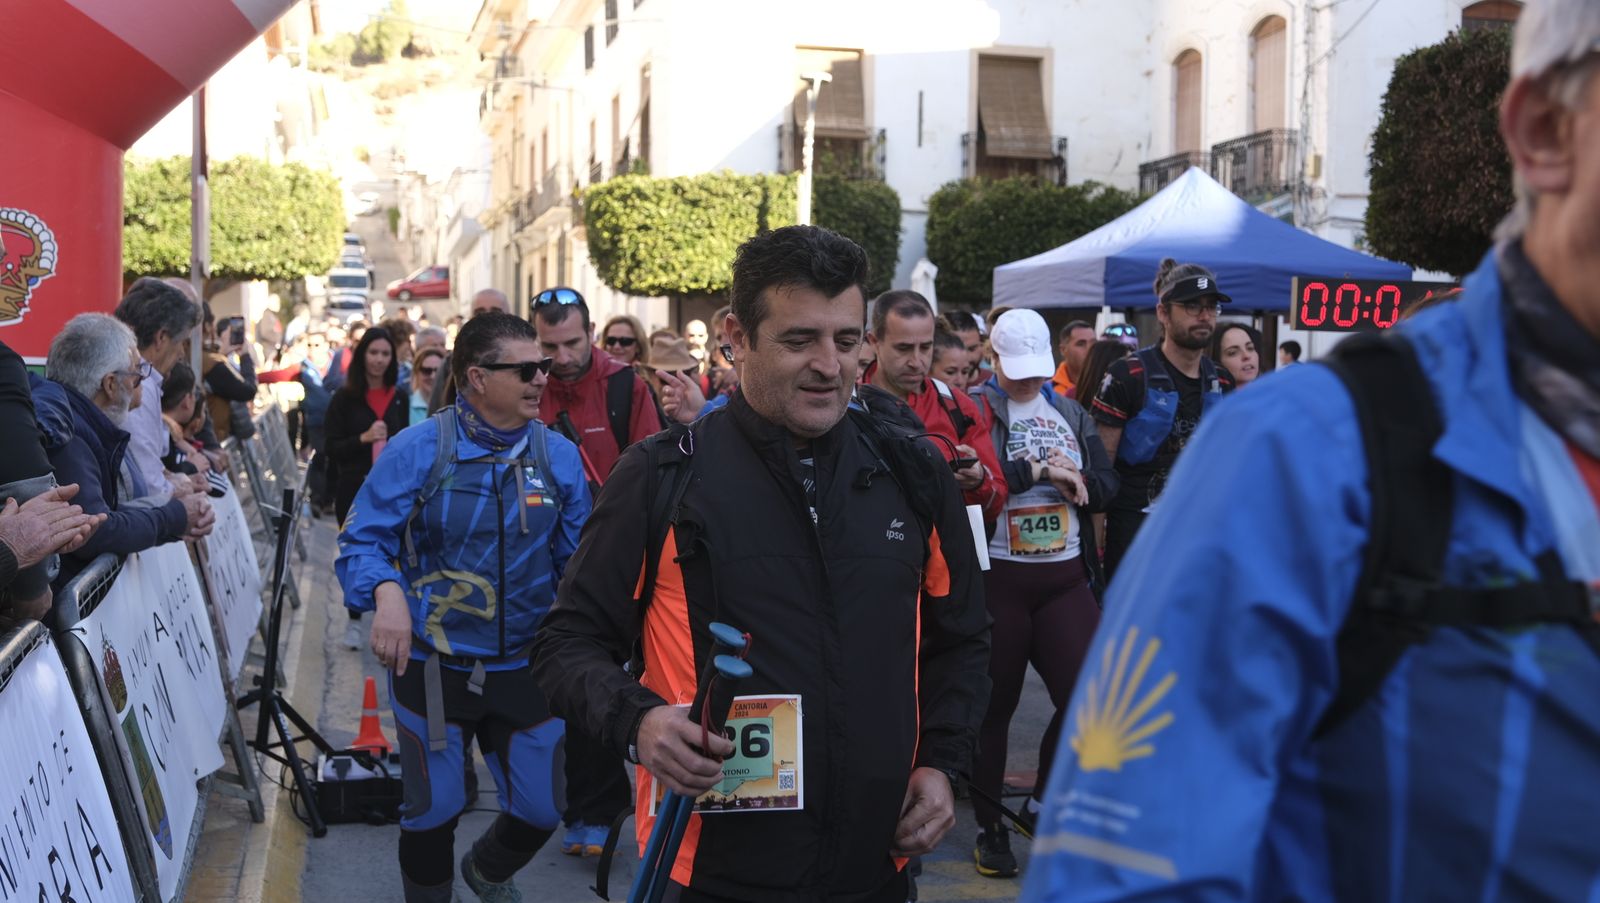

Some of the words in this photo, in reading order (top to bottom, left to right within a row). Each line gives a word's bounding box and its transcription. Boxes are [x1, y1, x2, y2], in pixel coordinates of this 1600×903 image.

[1020, 515, 1061, 534] 449
[734, 702, 768, 712] CANTORIA
[734, 710, 749, 718] 2024
[53, 729, 73, 787] DE
[721, 768, 750, 777] NTONIO
[38, 798, 113, 903] RIA
